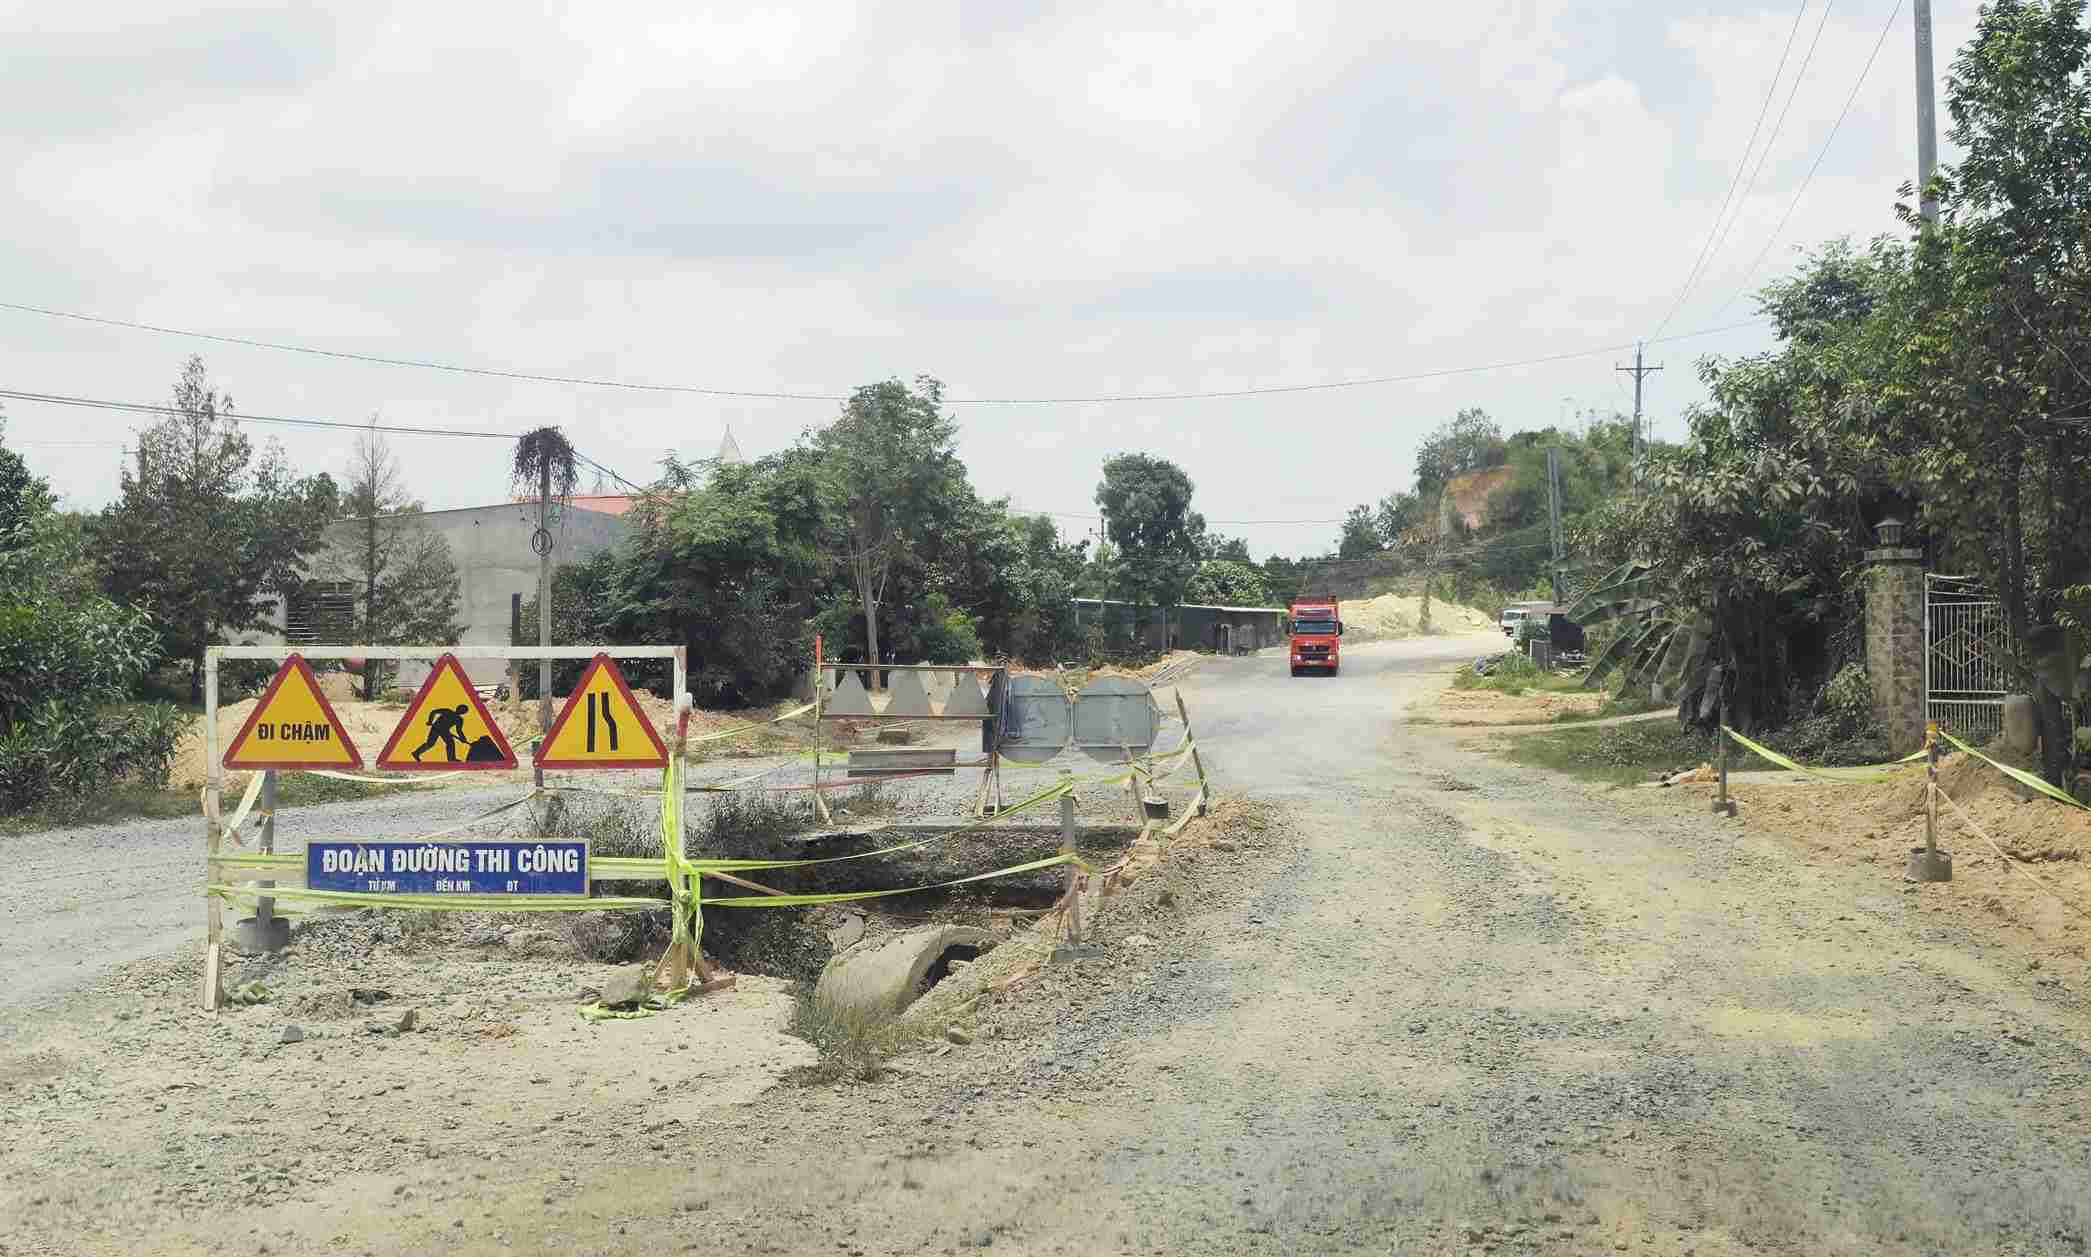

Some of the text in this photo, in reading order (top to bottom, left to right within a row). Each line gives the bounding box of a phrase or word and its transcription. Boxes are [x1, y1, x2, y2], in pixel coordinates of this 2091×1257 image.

[258, 720, 330, 744] ĐI CHẬM
[322, 843, 578, 876] ĐOẠN ĐƯỜNG THI CÔNG
